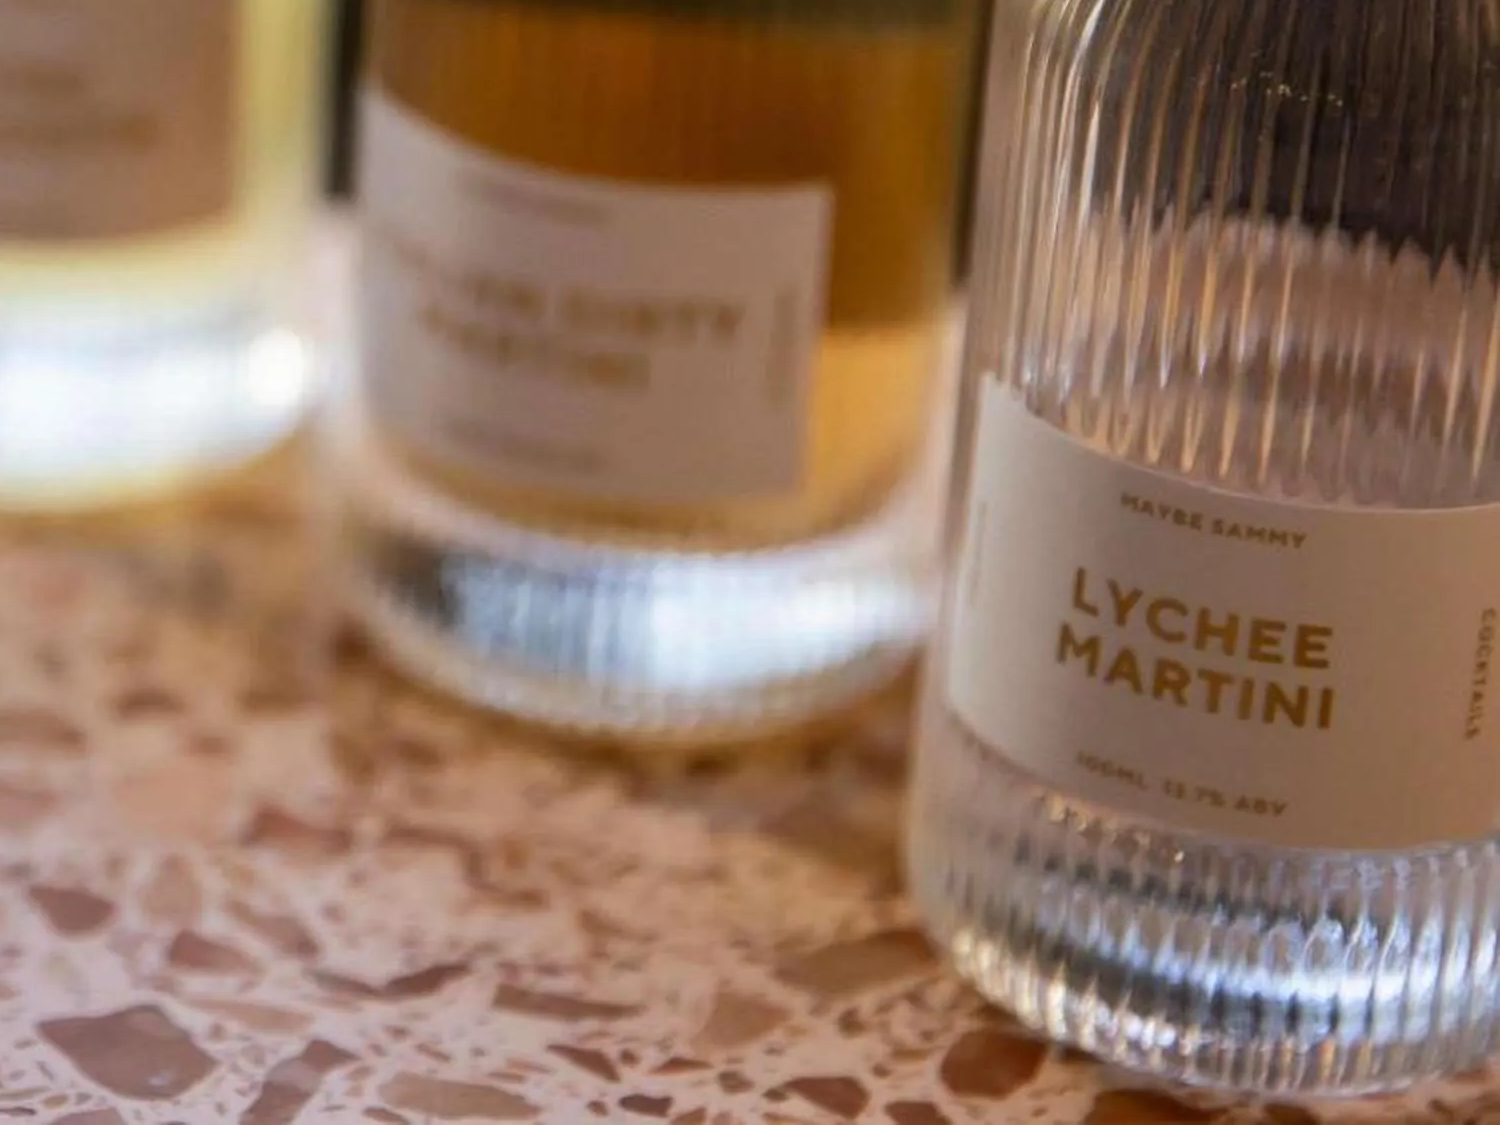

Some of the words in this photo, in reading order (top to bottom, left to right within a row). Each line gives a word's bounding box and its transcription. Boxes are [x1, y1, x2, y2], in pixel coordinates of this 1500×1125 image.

[1120, 491, 1204, 531] MAYBE
[1211, 518, 1307, 549] SAMMY
[1070, 566, 1333, 669] LYCHEE
[1055, 622, 1335, 731] MARTINI
[1464, 607, 1497, 740] COCKTAILS
[1233, 795, 1288, 817] ABV
